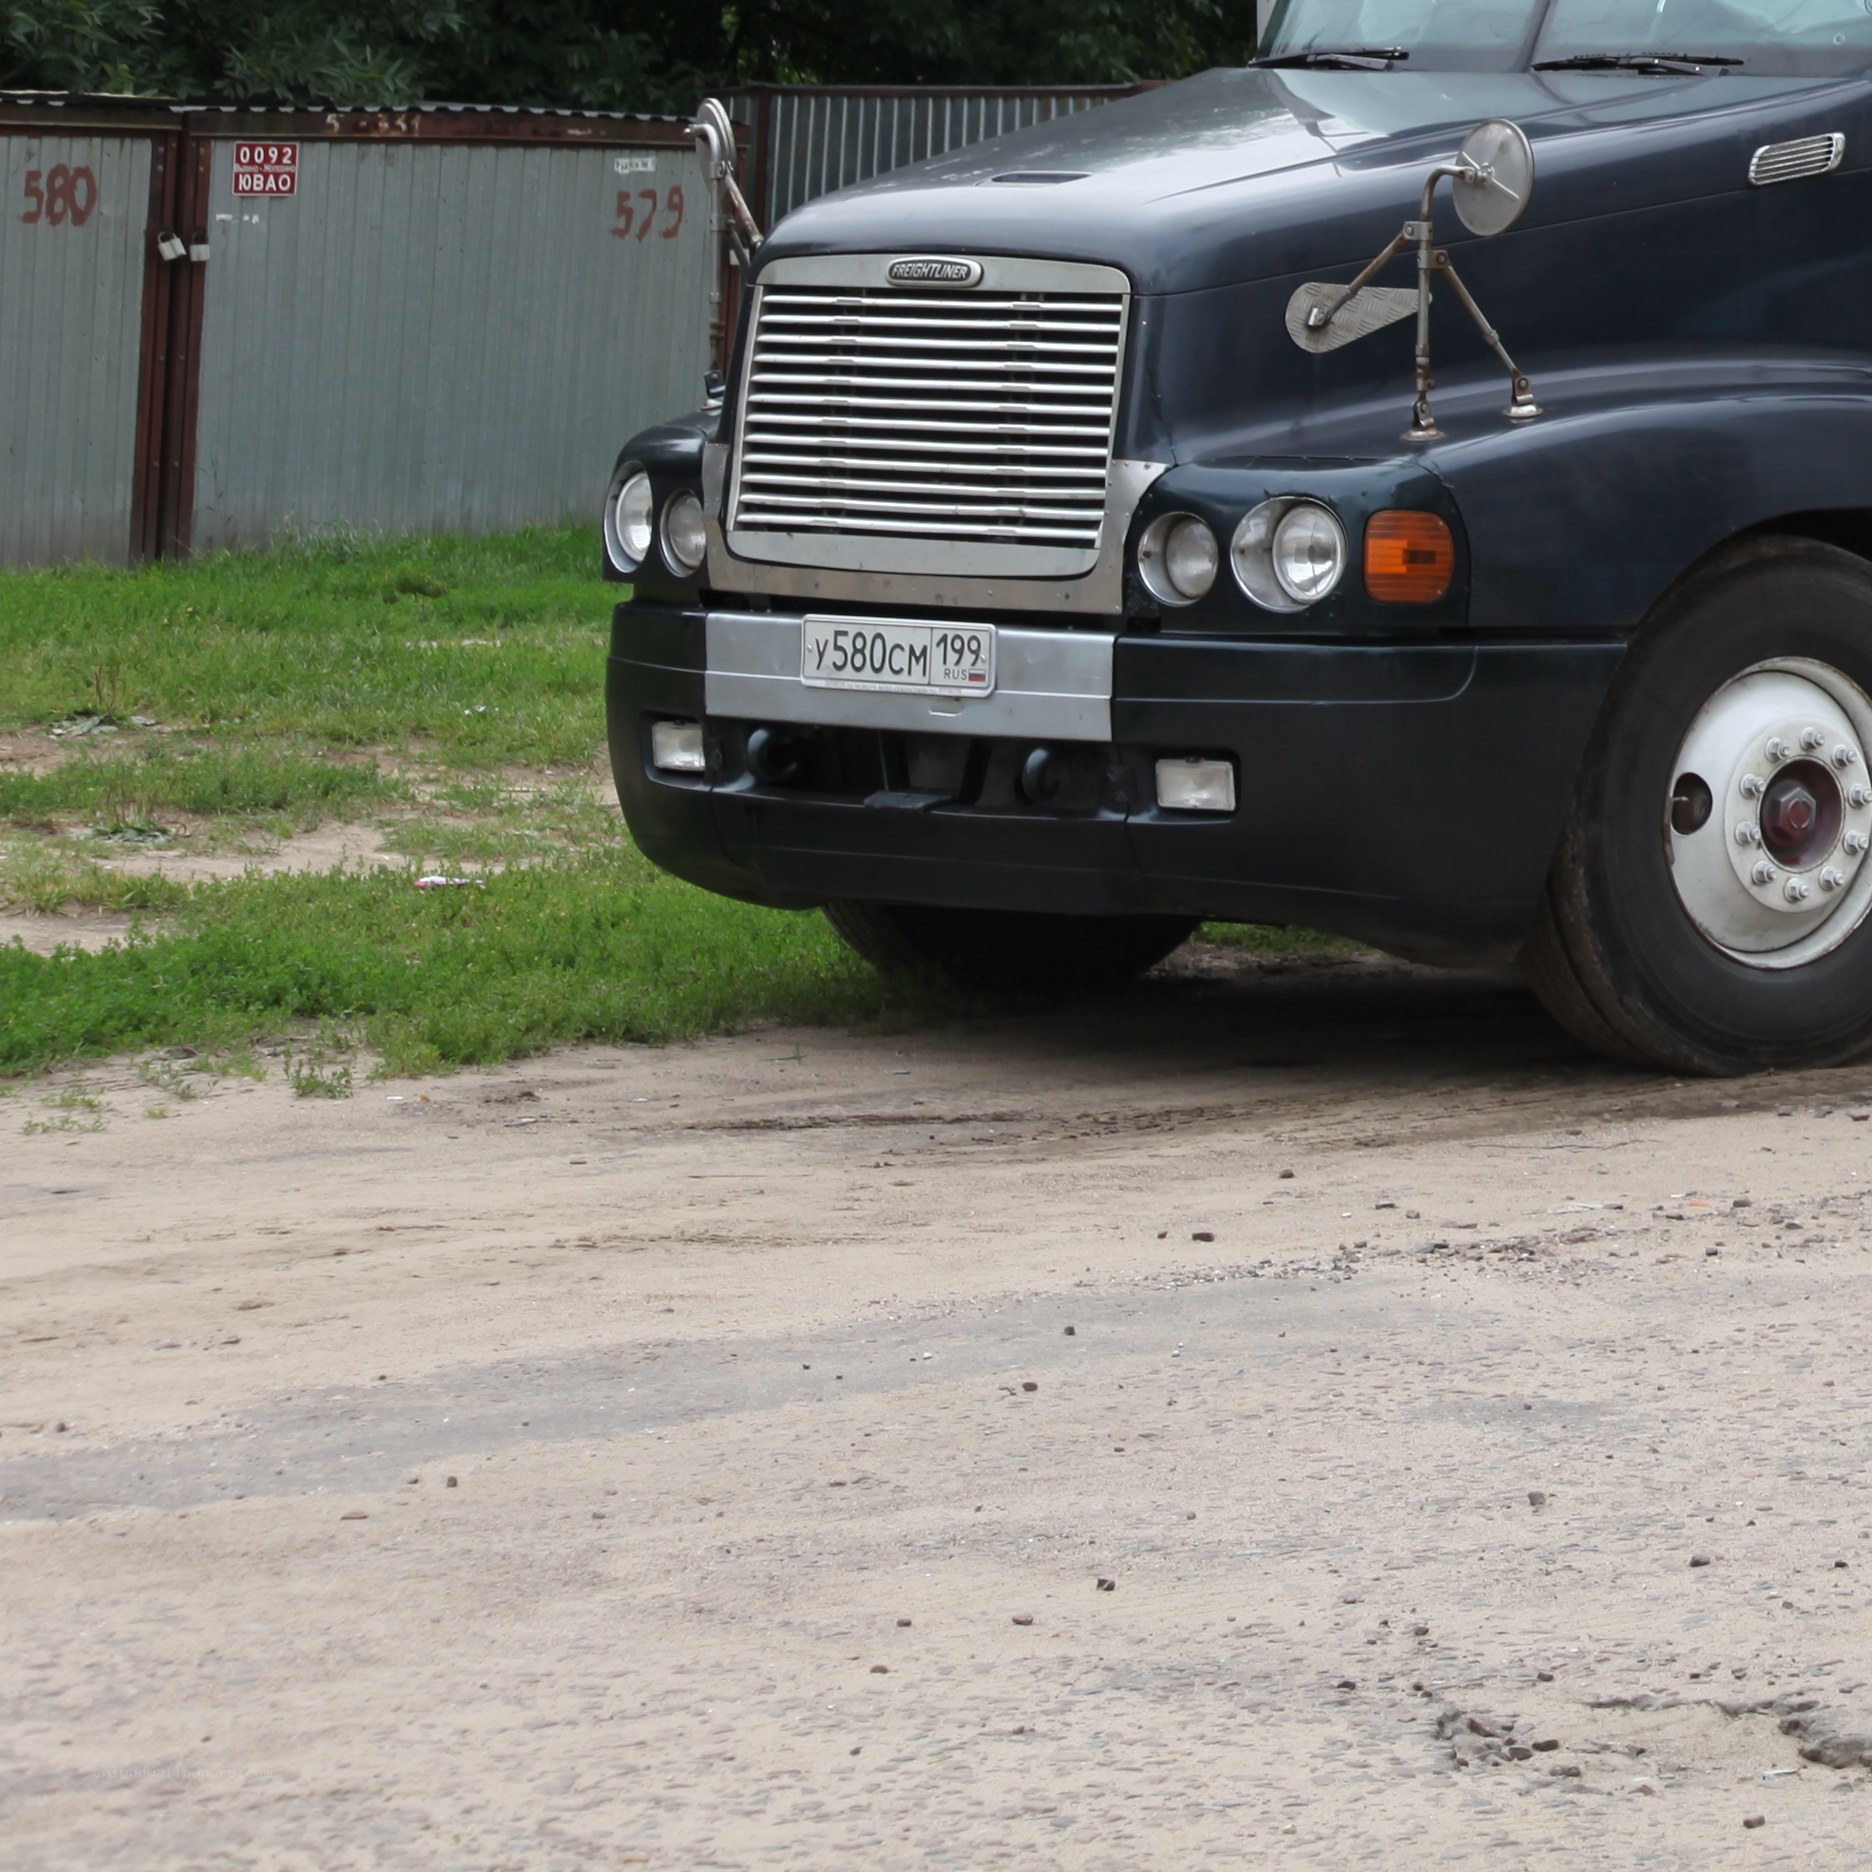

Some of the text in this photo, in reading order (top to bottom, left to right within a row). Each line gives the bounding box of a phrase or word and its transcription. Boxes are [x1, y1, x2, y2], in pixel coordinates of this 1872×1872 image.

[239, 146, 292, 164] 0092
[238, 173, 292, 192] ЮВАО
[22, 163, 98, 227] 580
[609, 183, 684, 242] 579
[891, 262, 968, 279] FREIGHTLINER
[936, 633, 981, 666] 199
[943, 669, 967, 680] RUS
